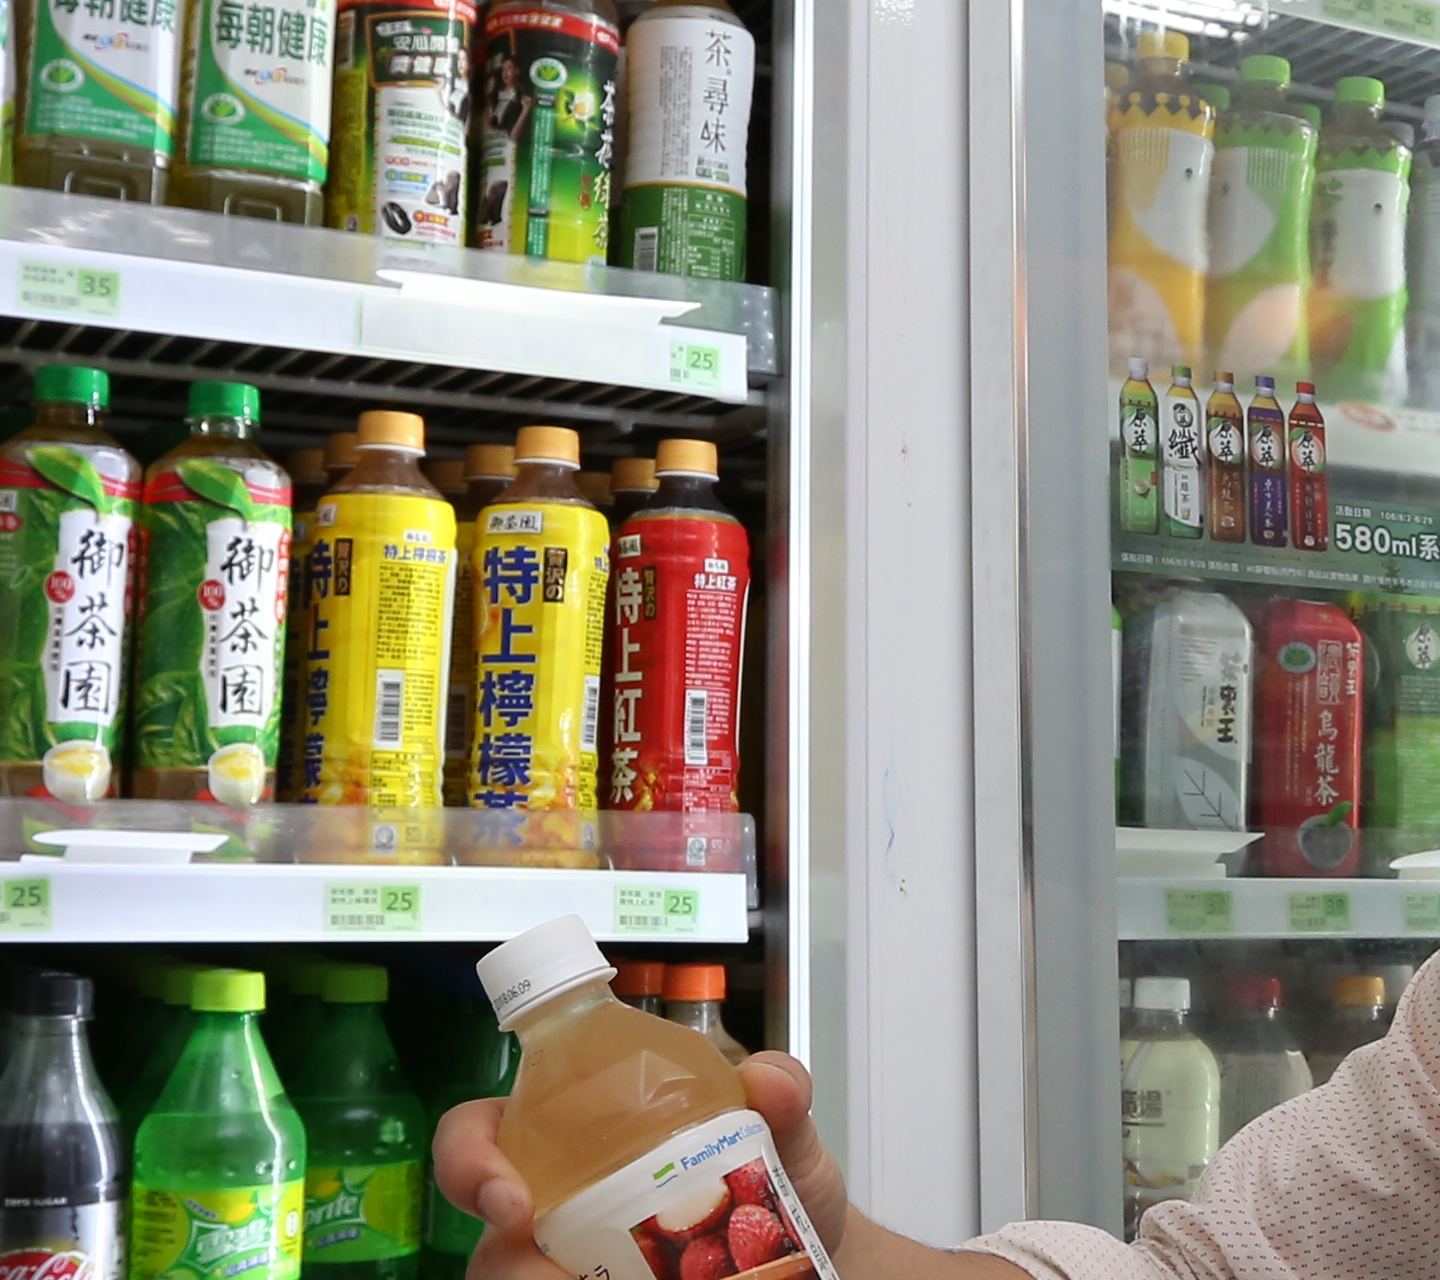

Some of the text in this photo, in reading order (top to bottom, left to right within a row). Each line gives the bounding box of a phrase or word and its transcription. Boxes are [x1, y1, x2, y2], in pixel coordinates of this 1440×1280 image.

[82, 275, 112, 296] 35
[690, 351, 714, 370] 25
[1168, 428, 1202, 466] 纖
[382, 544, 448, 564] 特上檸檬茶
[694, 573, 739, 592] 特上紅茶
[60, 529, 124, 715] 御茶園
[219, 535, 275, 717] 御茶園
[476, 546, 540, 848] 特上檸檬茶
[611, 567, 644, 806] 特上紅茶
[1312, 709, 1340, 805] 烏龍茶
[11, 885, 42, 907] 25
[386, 891, 413, 911] 25
[669, 896, 693, 914] 25
[680, 1130, 743, 1170] FamilyMart
[306, 1192, 359, 1228] prite
